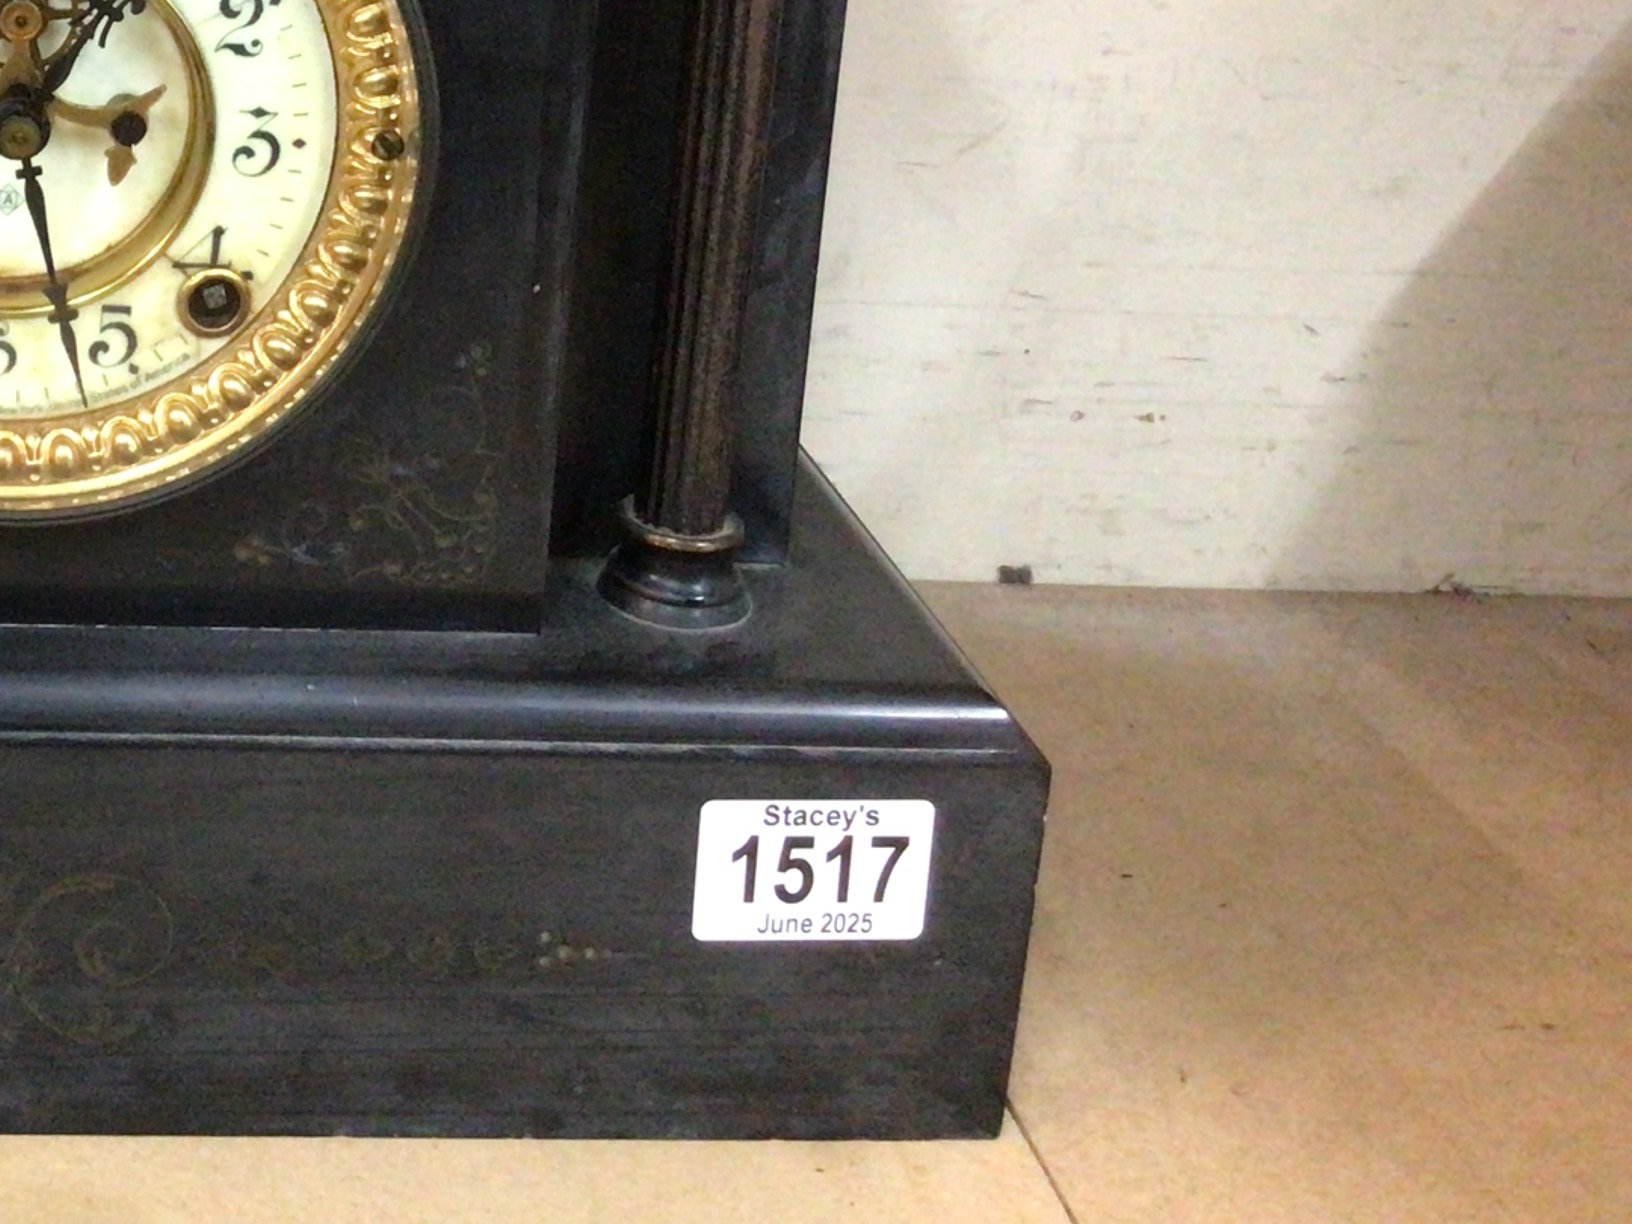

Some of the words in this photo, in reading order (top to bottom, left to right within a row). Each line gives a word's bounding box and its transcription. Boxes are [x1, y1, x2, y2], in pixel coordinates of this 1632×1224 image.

[232, 107, 282, 177] 3
[171, 225, 233, 271] 4
[88, 304, 138, 368] 5
[763, 804, 880, 832] Stacey's
[731, 835, 910, 904] 1517
[757, 913, 813, 933] June
[820, 913, 873, 933] 2025
